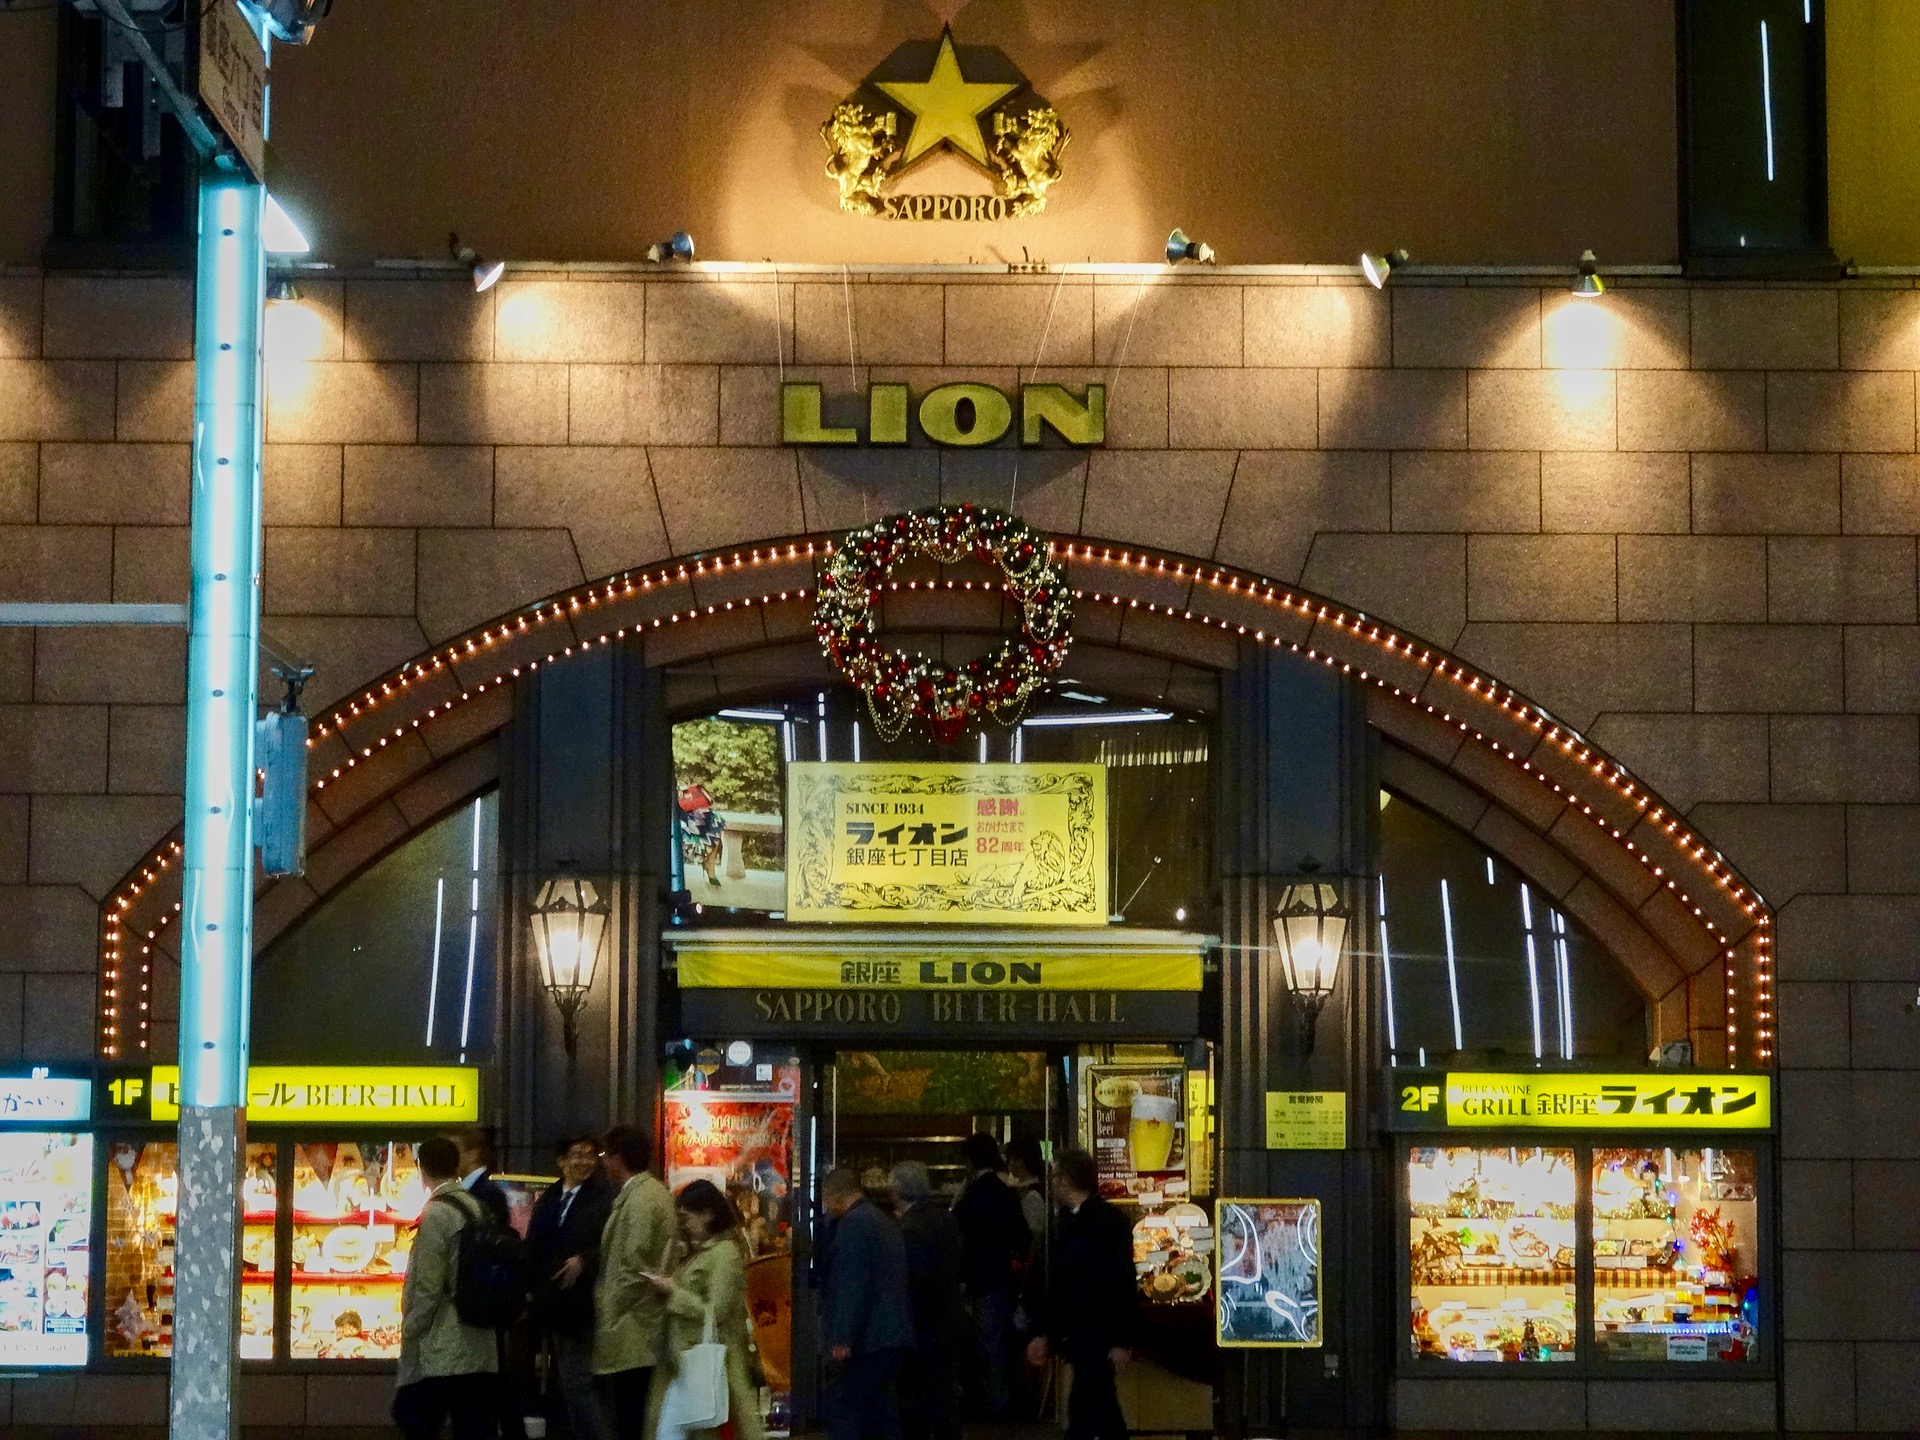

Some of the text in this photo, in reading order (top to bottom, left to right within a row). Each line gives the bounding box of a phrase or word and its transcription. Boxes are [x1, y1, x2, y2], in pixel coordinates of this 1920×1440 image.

[883, 194, 1008, 222] SAPPORO
[782, 382, 1106, 447] LION
[846, 803, 924, 815] SINCE 1934
[846, 822, 969, 846] ライオン
[976, 821, 1025, 833] おかげさまで
[846, 848, 969, 867] 銀座七丁目店
[841, 961, 1041, 984] 銀座 LION
[755, 991, 1125, 1024] SAPPORO BEER-HALL
[108, 1079, 143, 1105] 1F
[306, 1084, 465, 1107] BEER-HALL
[1401, 1086, 1439, 1112] 2F
[1462, 1098, 1531, 1115] GRILL
